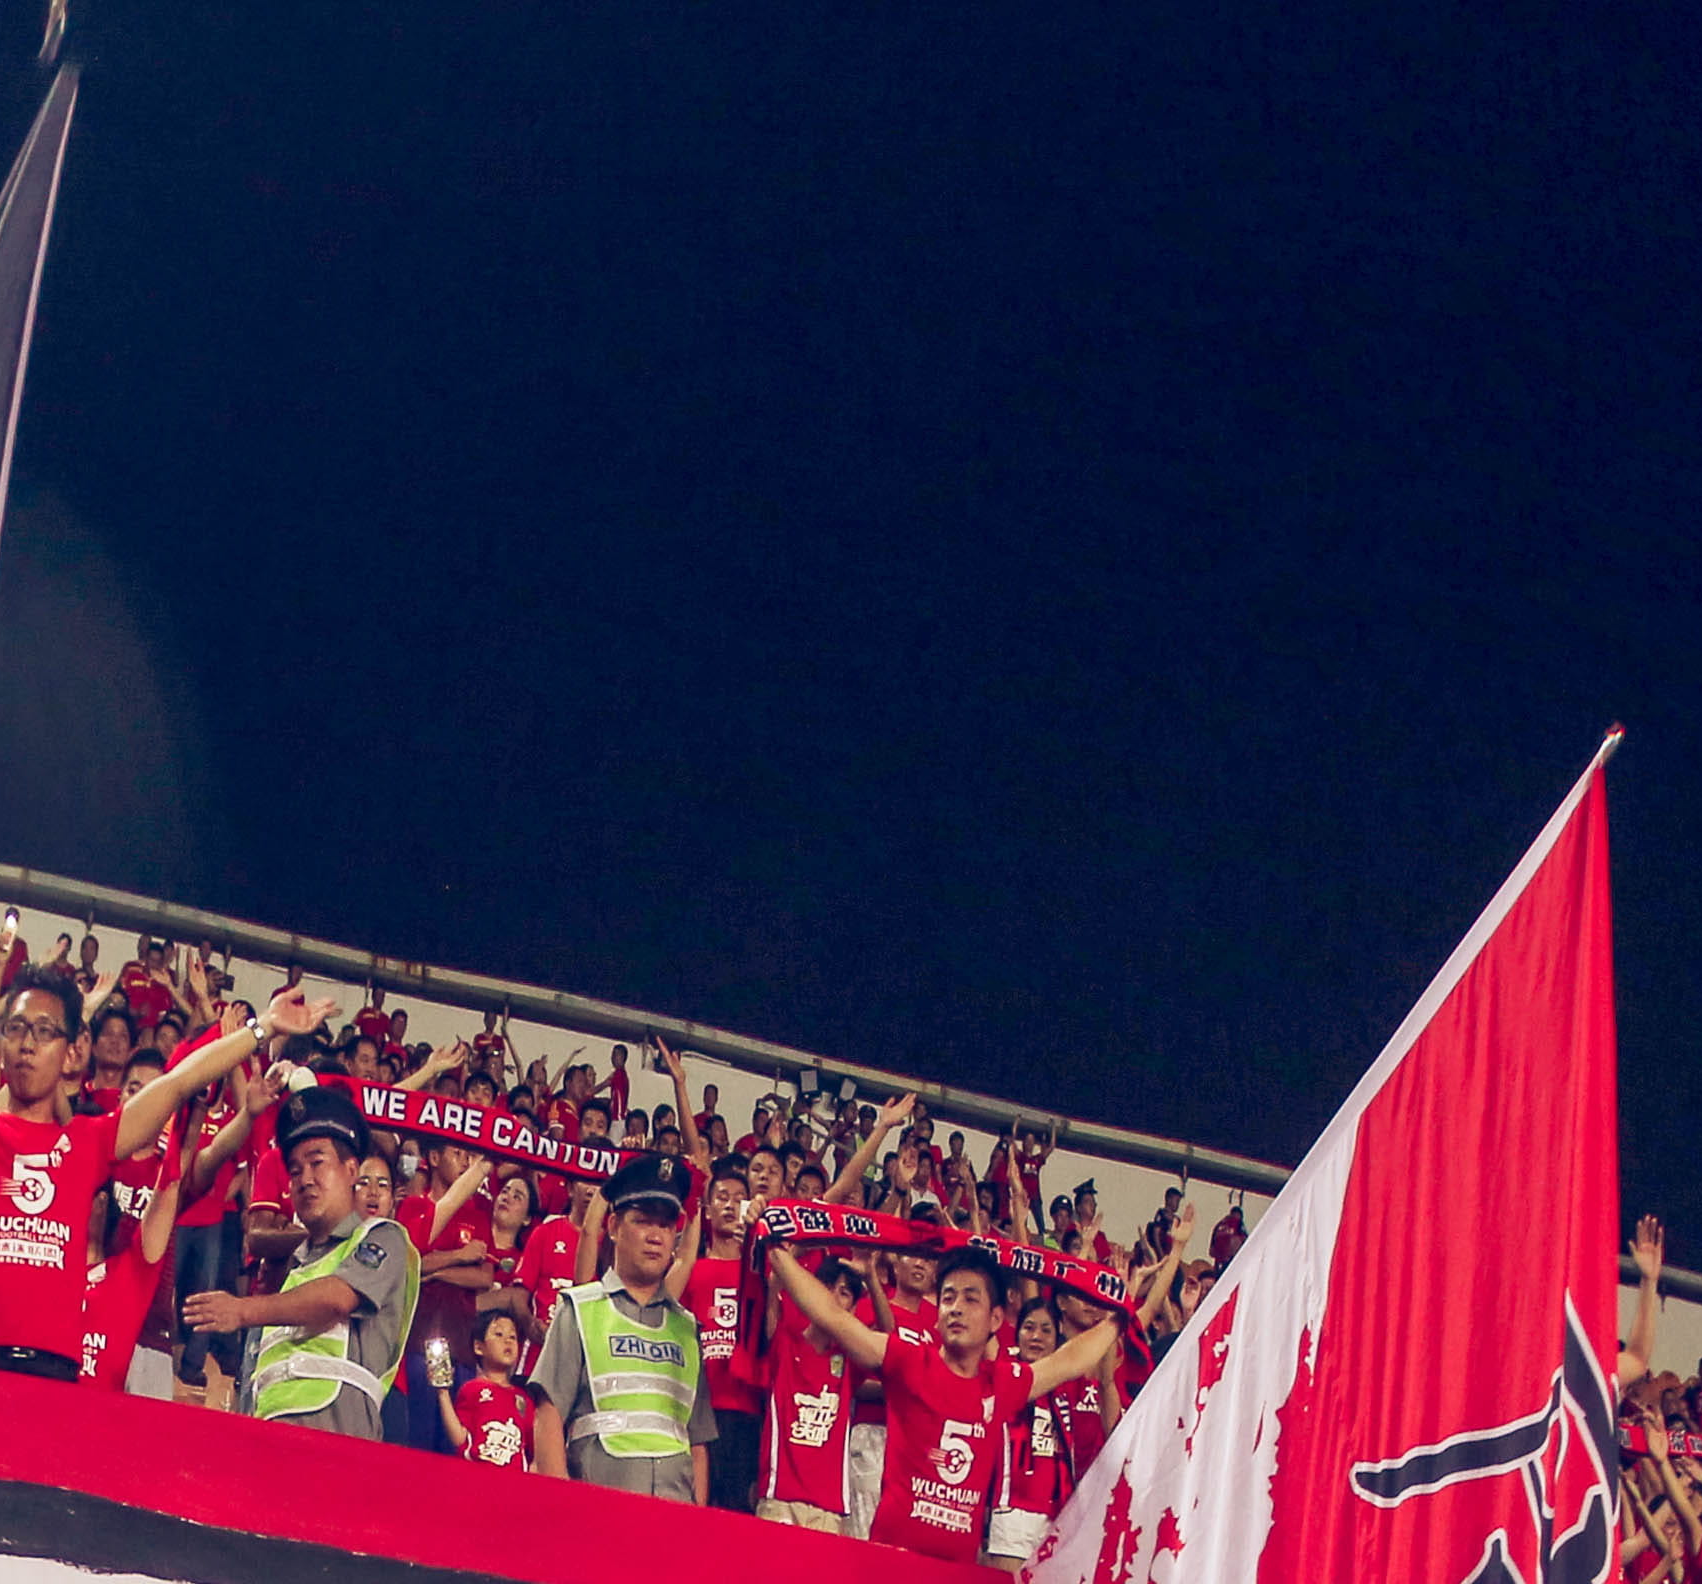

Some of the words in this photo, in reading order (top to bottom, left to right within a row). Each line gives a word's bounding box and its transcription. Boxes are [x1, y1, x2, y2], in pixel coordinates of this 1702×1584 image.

[362, 1086, 406, 1121] WE
[418, 1099, 483, 1138] ARE
[491, 1116, 620, 1177] CANTON
[911, 1476, 981, 1505] WUCHUAN
